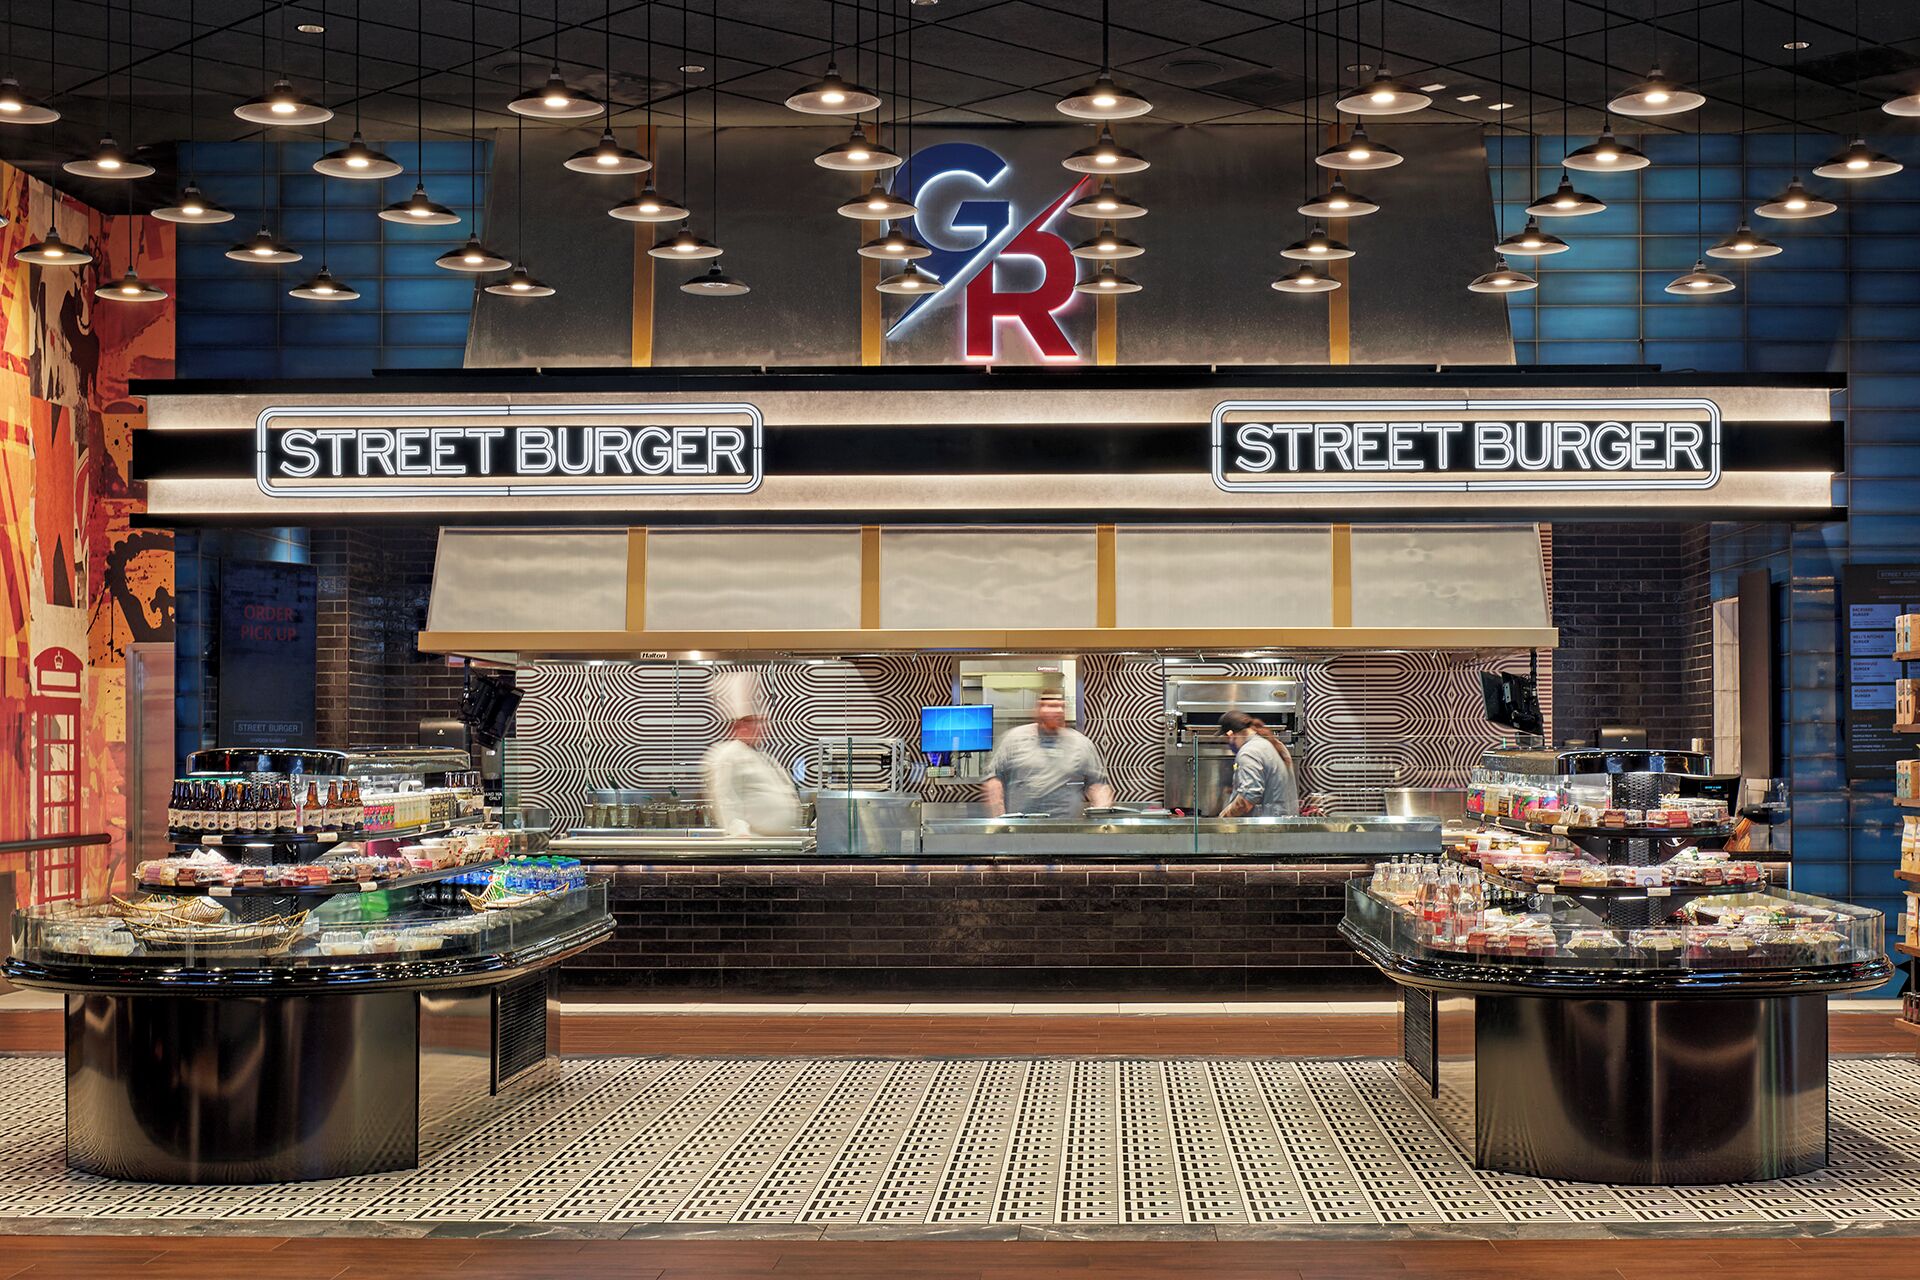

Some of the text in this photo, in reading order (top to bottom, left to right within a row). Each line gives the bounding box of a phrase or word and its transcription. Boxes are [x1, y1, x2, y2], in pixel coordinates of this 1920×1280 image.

[280, 426, 745, 476] STREET BURGER
[1236, 421, 1703, 471] STREET BURGER
[243, 605, 295, 622] ORDER
[240, 625, 297, 641] PICK UP
[238, 723, 299, 733] STREET BURGER
